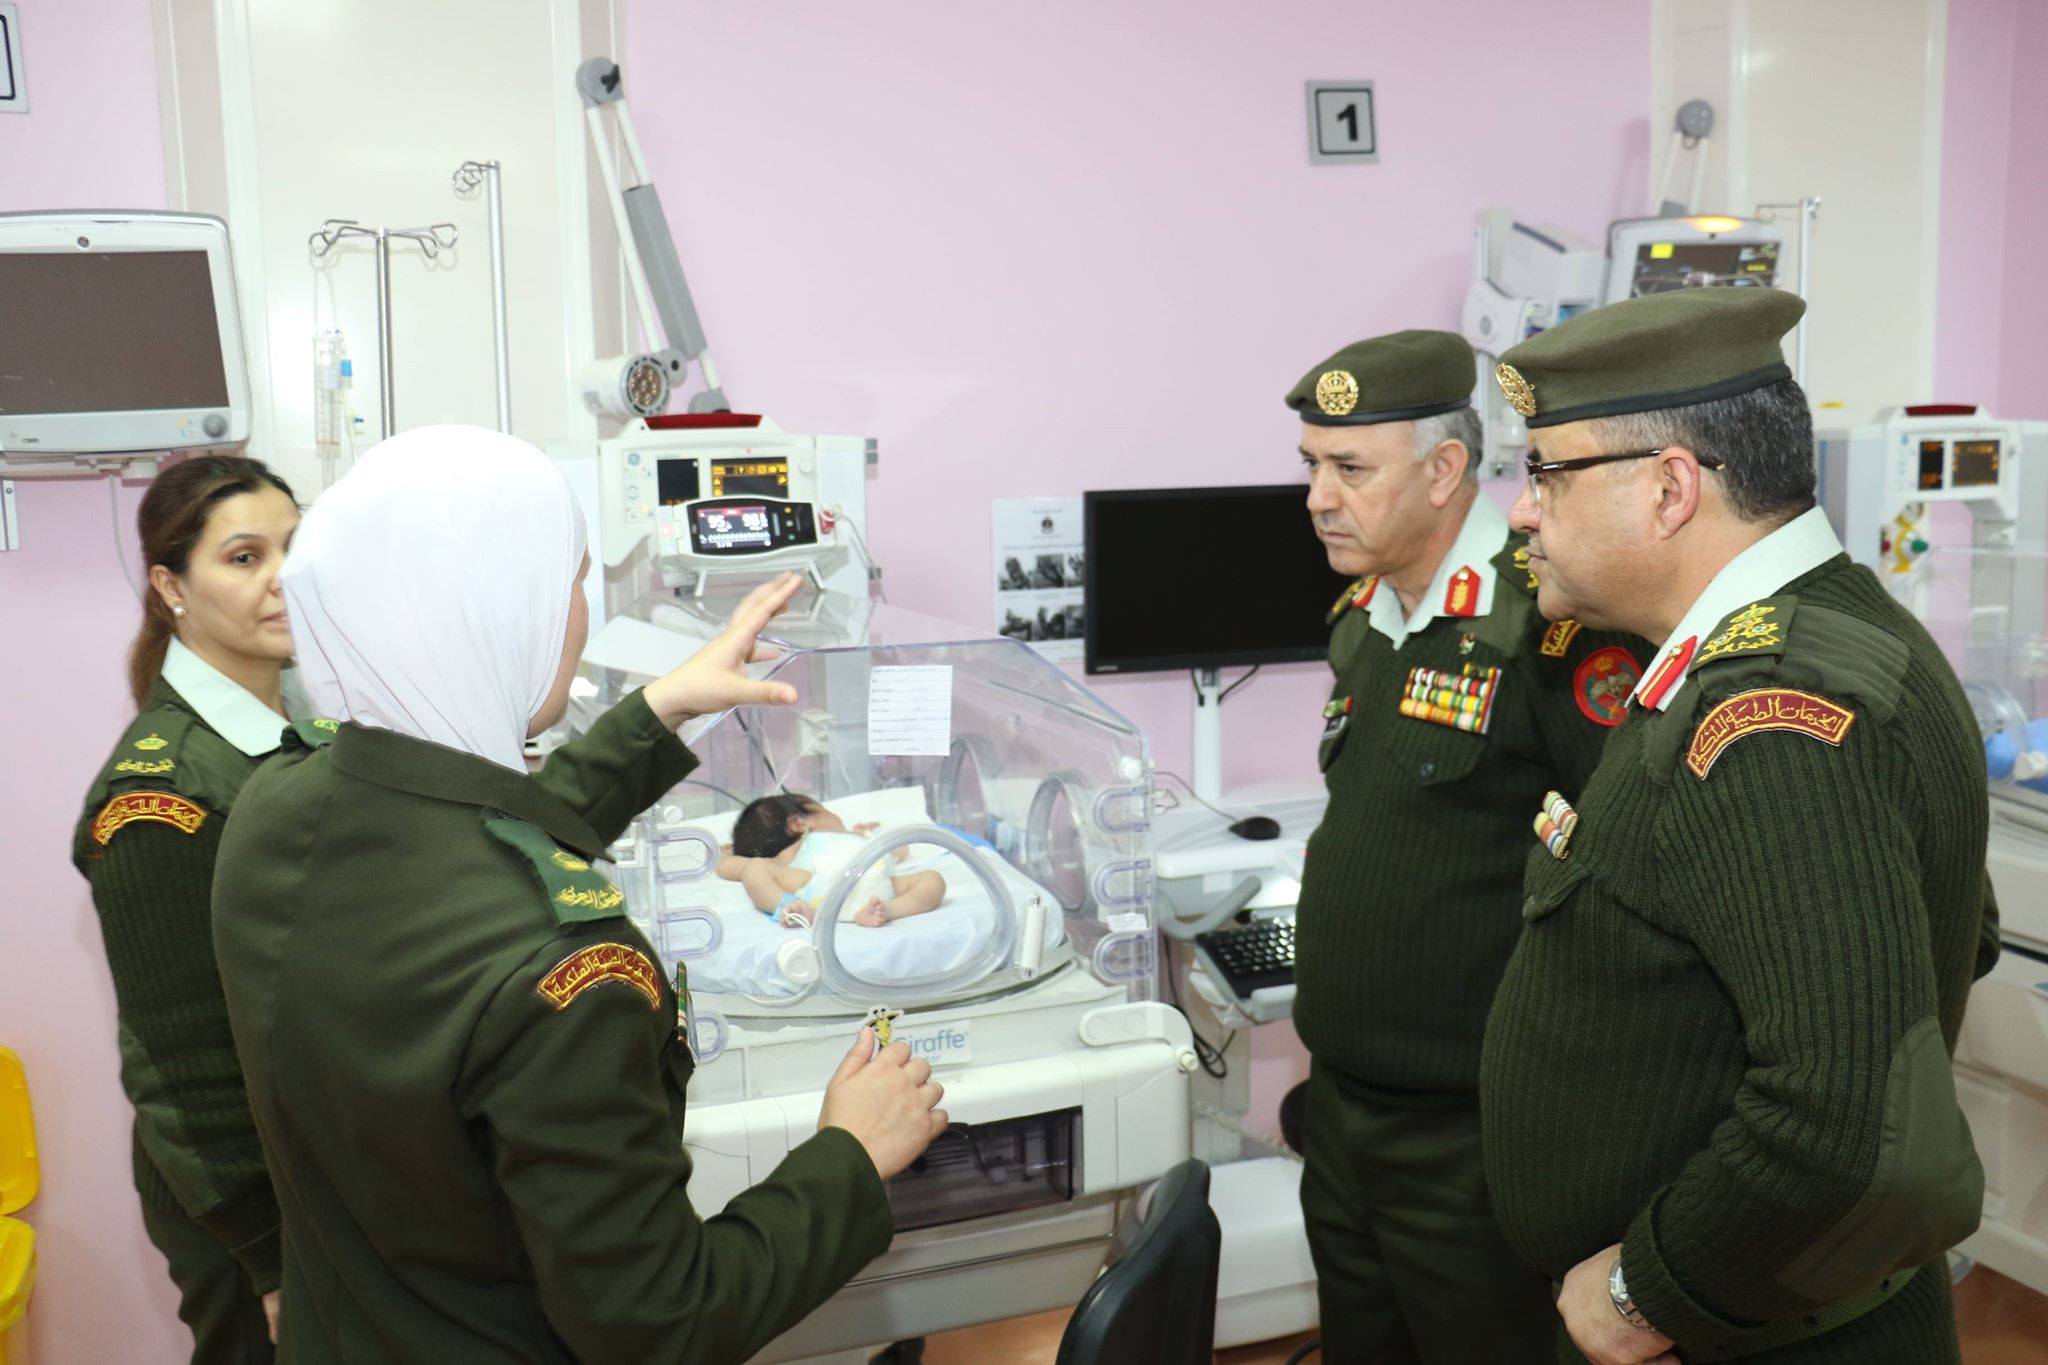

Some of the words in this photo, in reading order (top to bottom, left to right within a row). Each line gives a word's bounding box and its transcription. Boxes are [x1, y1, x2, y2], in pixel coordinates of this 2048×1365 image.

[1337, 104, 1357, 141] 1
[1726, 697, 1780, 728] الطبية
[894, 1029, 965, 1053] iraffe
